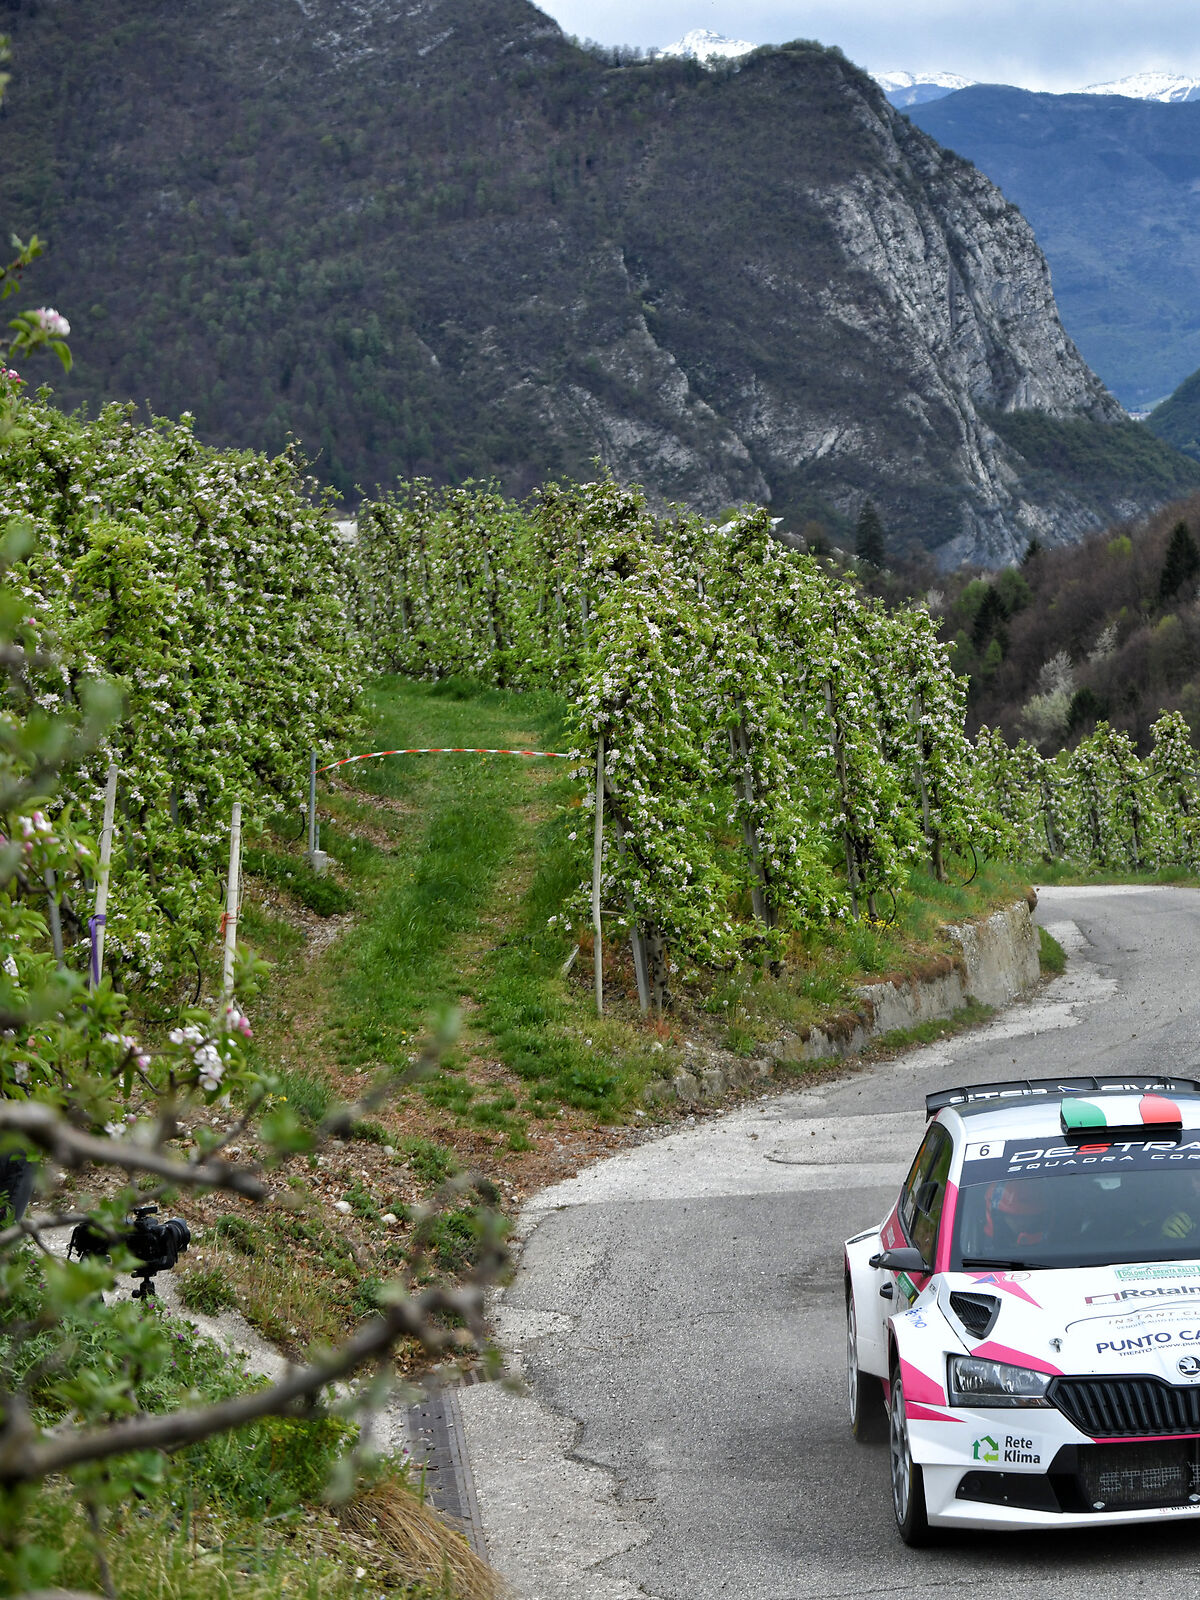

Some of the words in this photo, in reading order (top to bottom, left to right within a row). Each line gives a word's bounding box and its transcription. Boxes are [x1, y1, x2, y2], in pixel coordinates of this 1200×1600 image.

[980, 1144, 990, 1157] 6
[1007, 1155, 1134, 1173] SQUADRA
[1108, 1311, 1174, 1325] INSTANT
[1096, 1332, 1172, 1354] PUNTO
[1119, 1347, 1152, 1357] TRENTO
[1005, 1435, 1033, 1449] Rete
[1004, 1450, 1041, 1464] Klima
[1099, 1466, 1182, 1492] STEP
